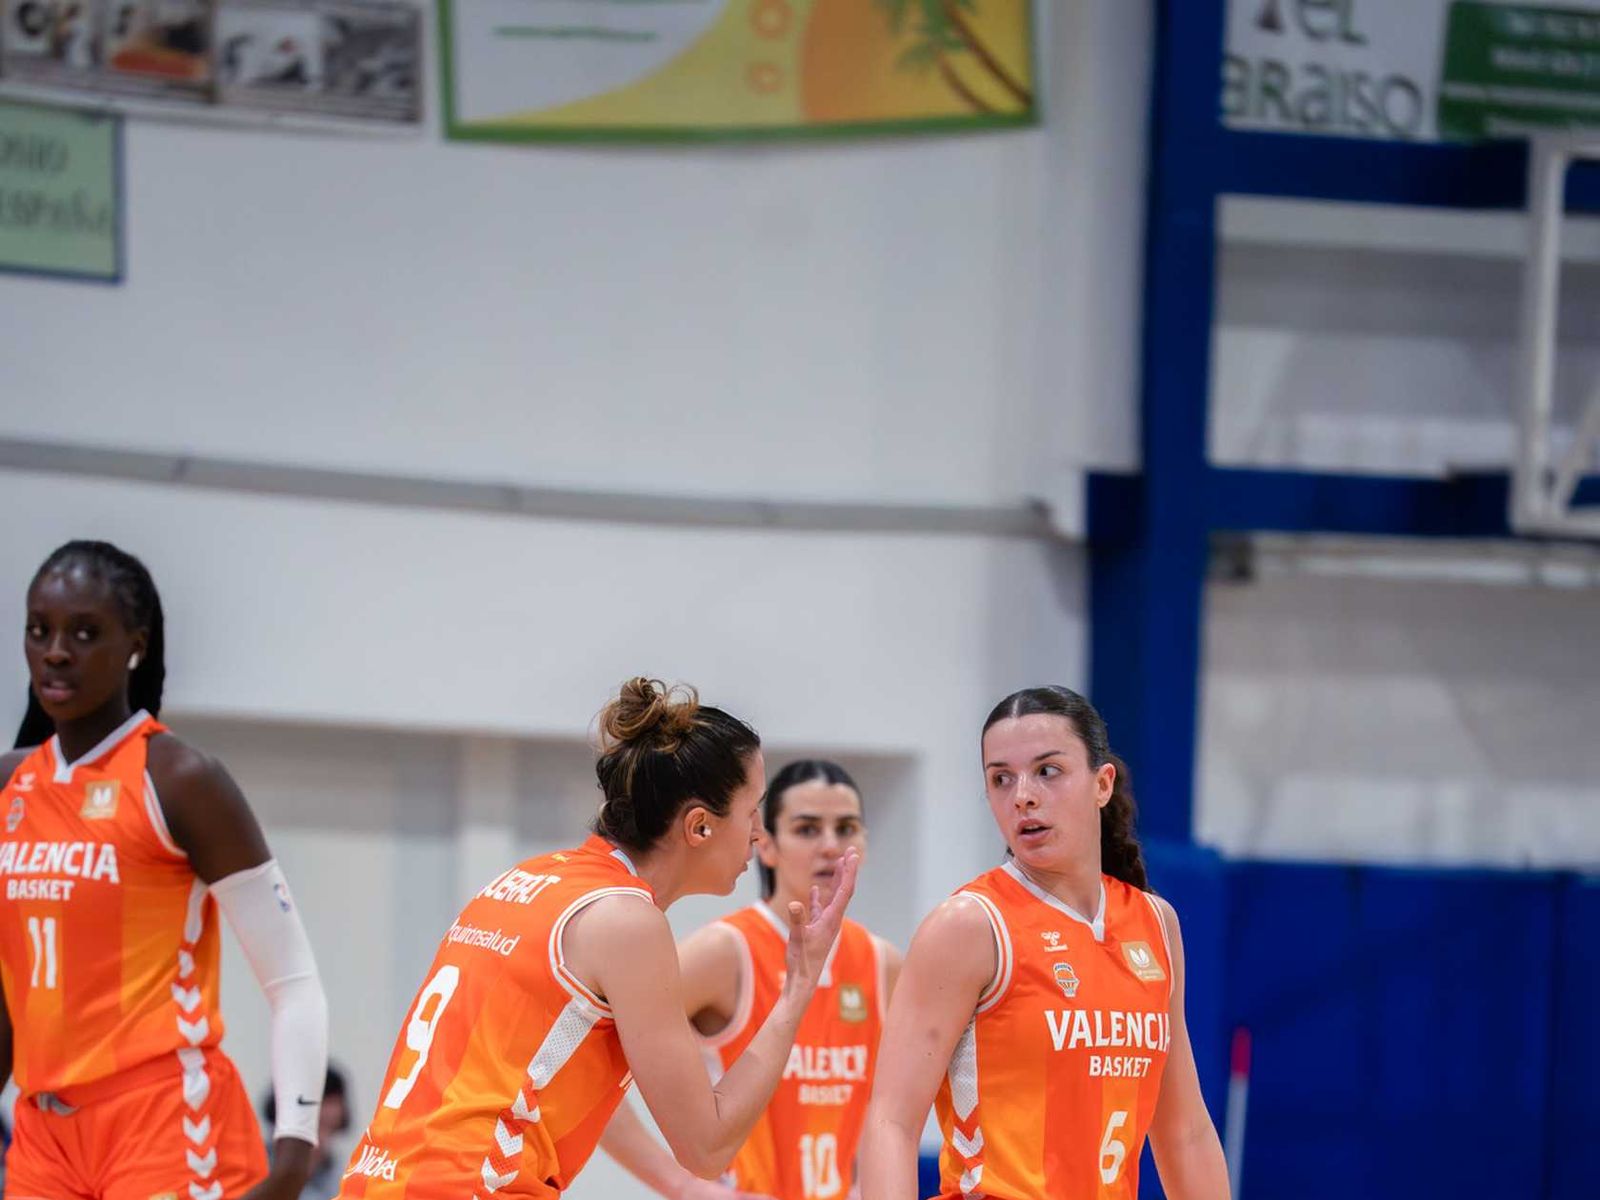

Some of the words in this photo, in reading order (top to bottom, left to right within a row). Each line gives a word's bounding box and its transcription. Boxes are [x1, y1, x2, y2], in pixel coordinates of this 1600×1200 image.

[0, 841, 120, 884] ALENCIA
[7, 879, 75, 901] BASKET
[476, 867, 561, 904] UERALT
[28, 916, 57, 989] 11
[383, 964, 460, 1109] 9
[1088, 1055, 1153, 1078] BASKET
[799, 1132, 842, 1199] 10
[1098, 1110, 1128, 1185] 6
